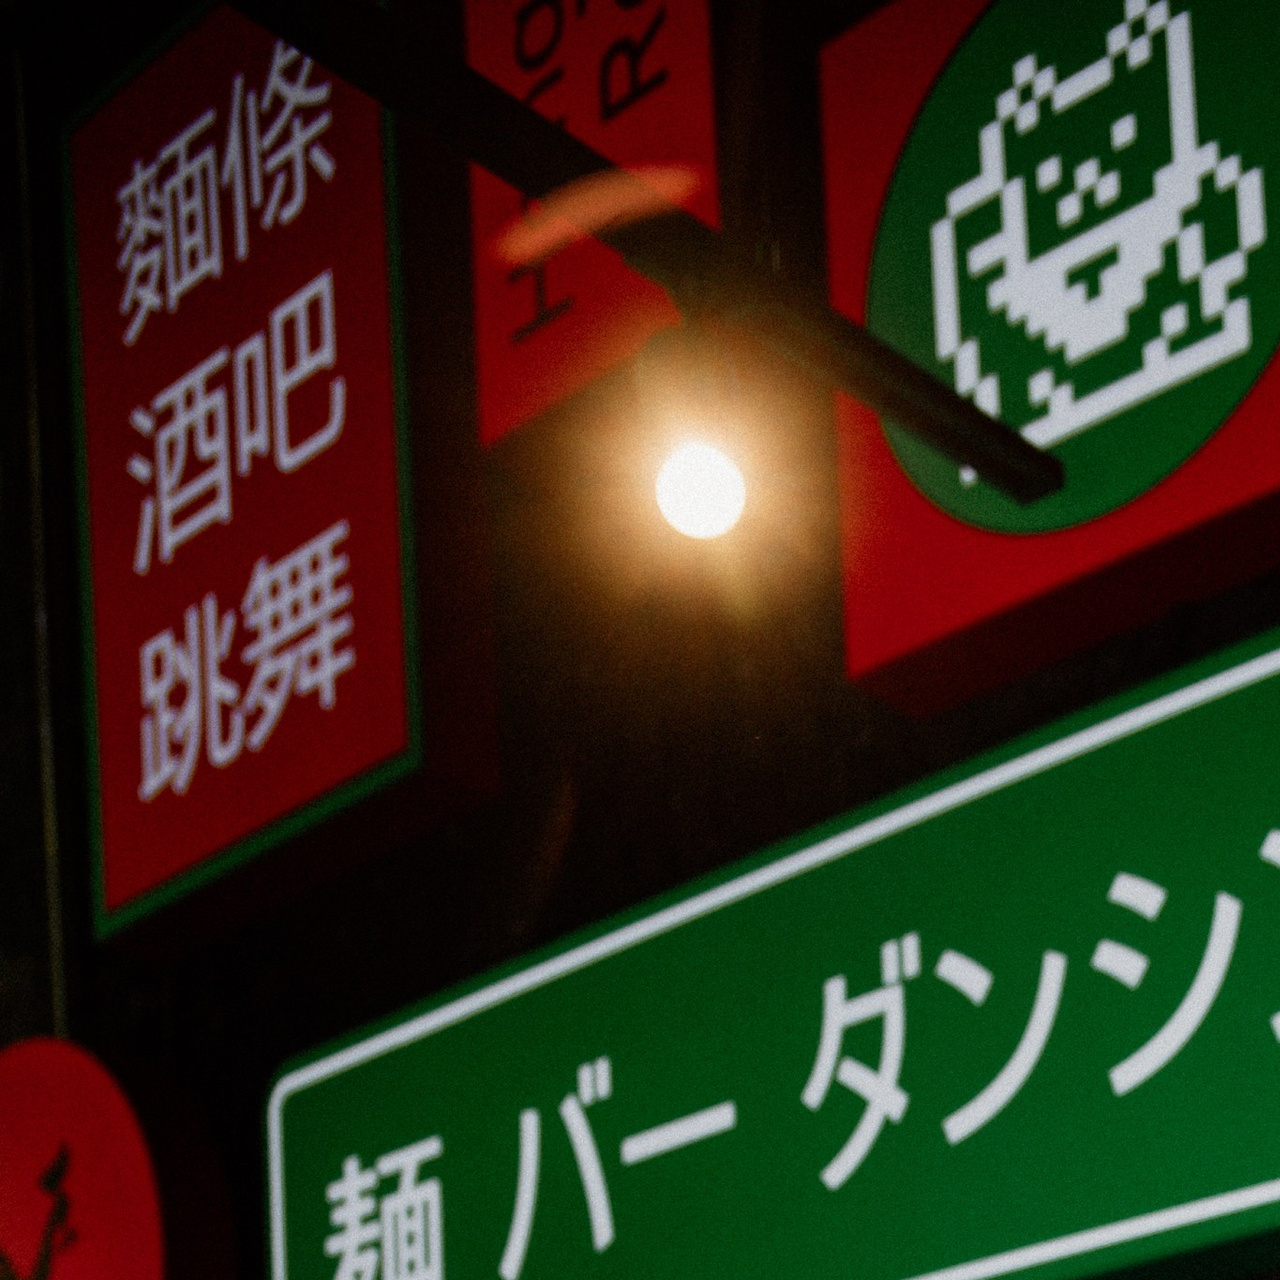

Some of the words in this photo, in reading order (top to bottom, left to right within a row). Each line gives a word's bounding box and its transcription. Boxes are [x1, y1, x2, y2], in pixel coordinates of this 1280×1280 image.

[116, 38, 336, 345] 麵條
[126, 269, 347, 575] 酒吧
[138, 518, 357, 802] 跳舞
